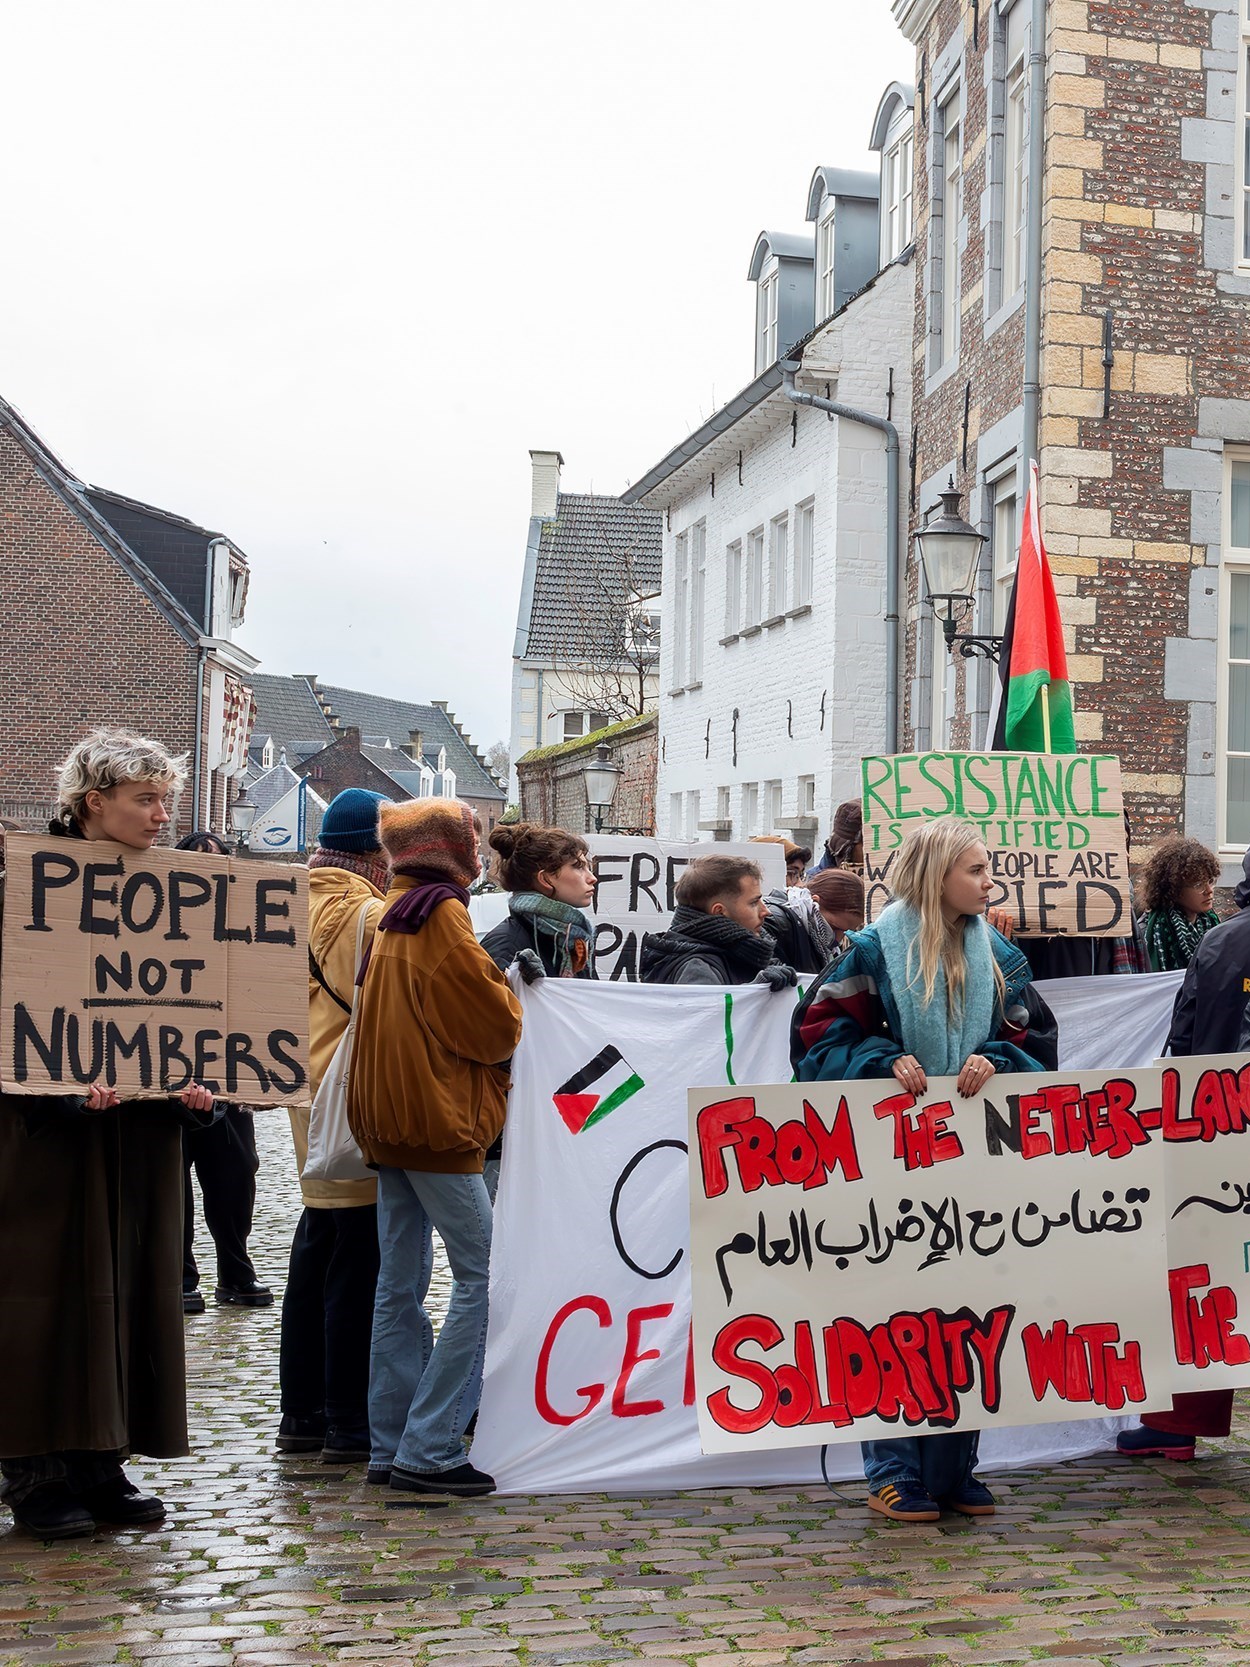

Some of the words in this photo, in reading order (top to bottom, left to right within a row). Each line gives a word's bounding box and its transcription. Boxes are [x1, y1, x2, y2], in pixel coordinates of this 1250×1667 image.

[862, 754, 1120, 823] RESISTANCE
[871, 822, 903, 850] IS
[1068, 851, 1121, 879] ARE
[23, 851, 297, 947] PEOPLE
[592, 852, 691, 915] FRE
[95, 951, 205, 995] NOT
[12, 1002, 307, 1094] NUMBERS
[697, 1095, 863, 1198] FROM
[873, 1092, 964, 1171] THE
[966, 1210, 1005, 1257] مع
[1012, 1187, 1150, 1247] تضامن
[716, 1207, 813, 1306] العام
[535, 1295, 695, 1426] GE
[1022, 1319, 1147, 1409] WITH
